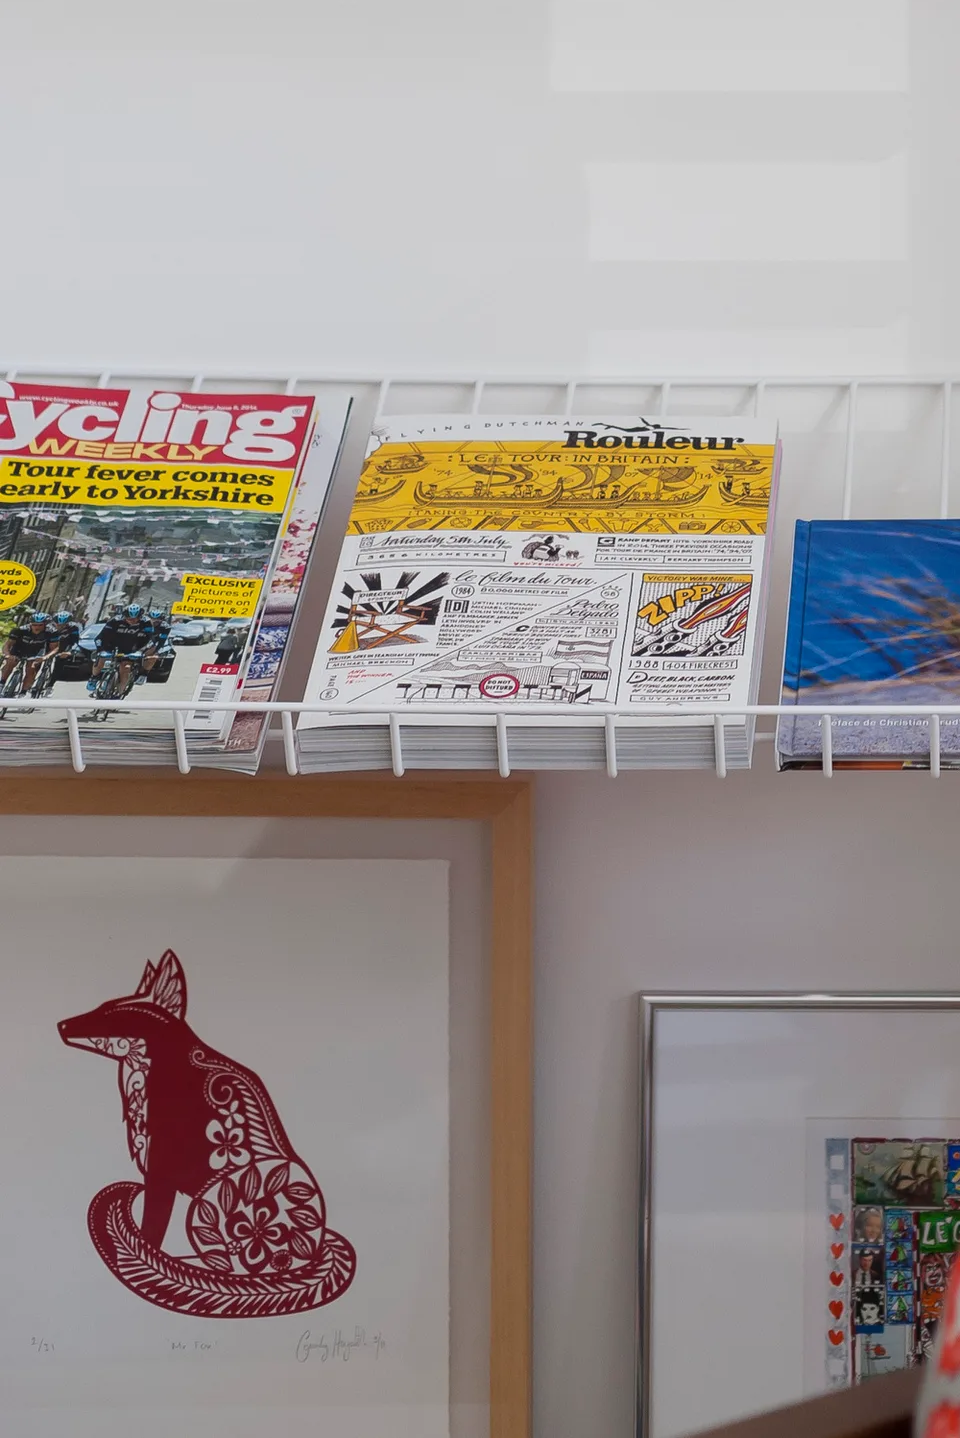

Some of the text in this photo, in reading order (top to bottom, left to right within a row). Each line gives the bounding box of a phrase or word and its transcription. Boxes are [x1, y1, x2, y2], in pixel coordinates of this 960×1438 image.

[484, 421, 584, 429] DUTCHMAN
[561, 430, 745, 451] Rouleur
[28, 438, 218, 461] WEEKLY
[597, 455, 679, 464] BRITAIN
[8, 461, 275, 487] Tour fever comes
[0, 481, 274, 506] early to Yorkshire
[376, 535, 446, 548] Saturday
[186, 576, 256, 588] EXCLUSIVE
[191, 588, 254, 598] pictures of
[455, 586, 471, 595] 1984
[187, 596, 233, 605] Froome
[176, 605, 215, 615] stages
[629, 660, 659, 668] 1988
[206, 666, 232, 674] £2.99
[863, 719, 877, 727] de
[879, 718, 929, 727] Christian
